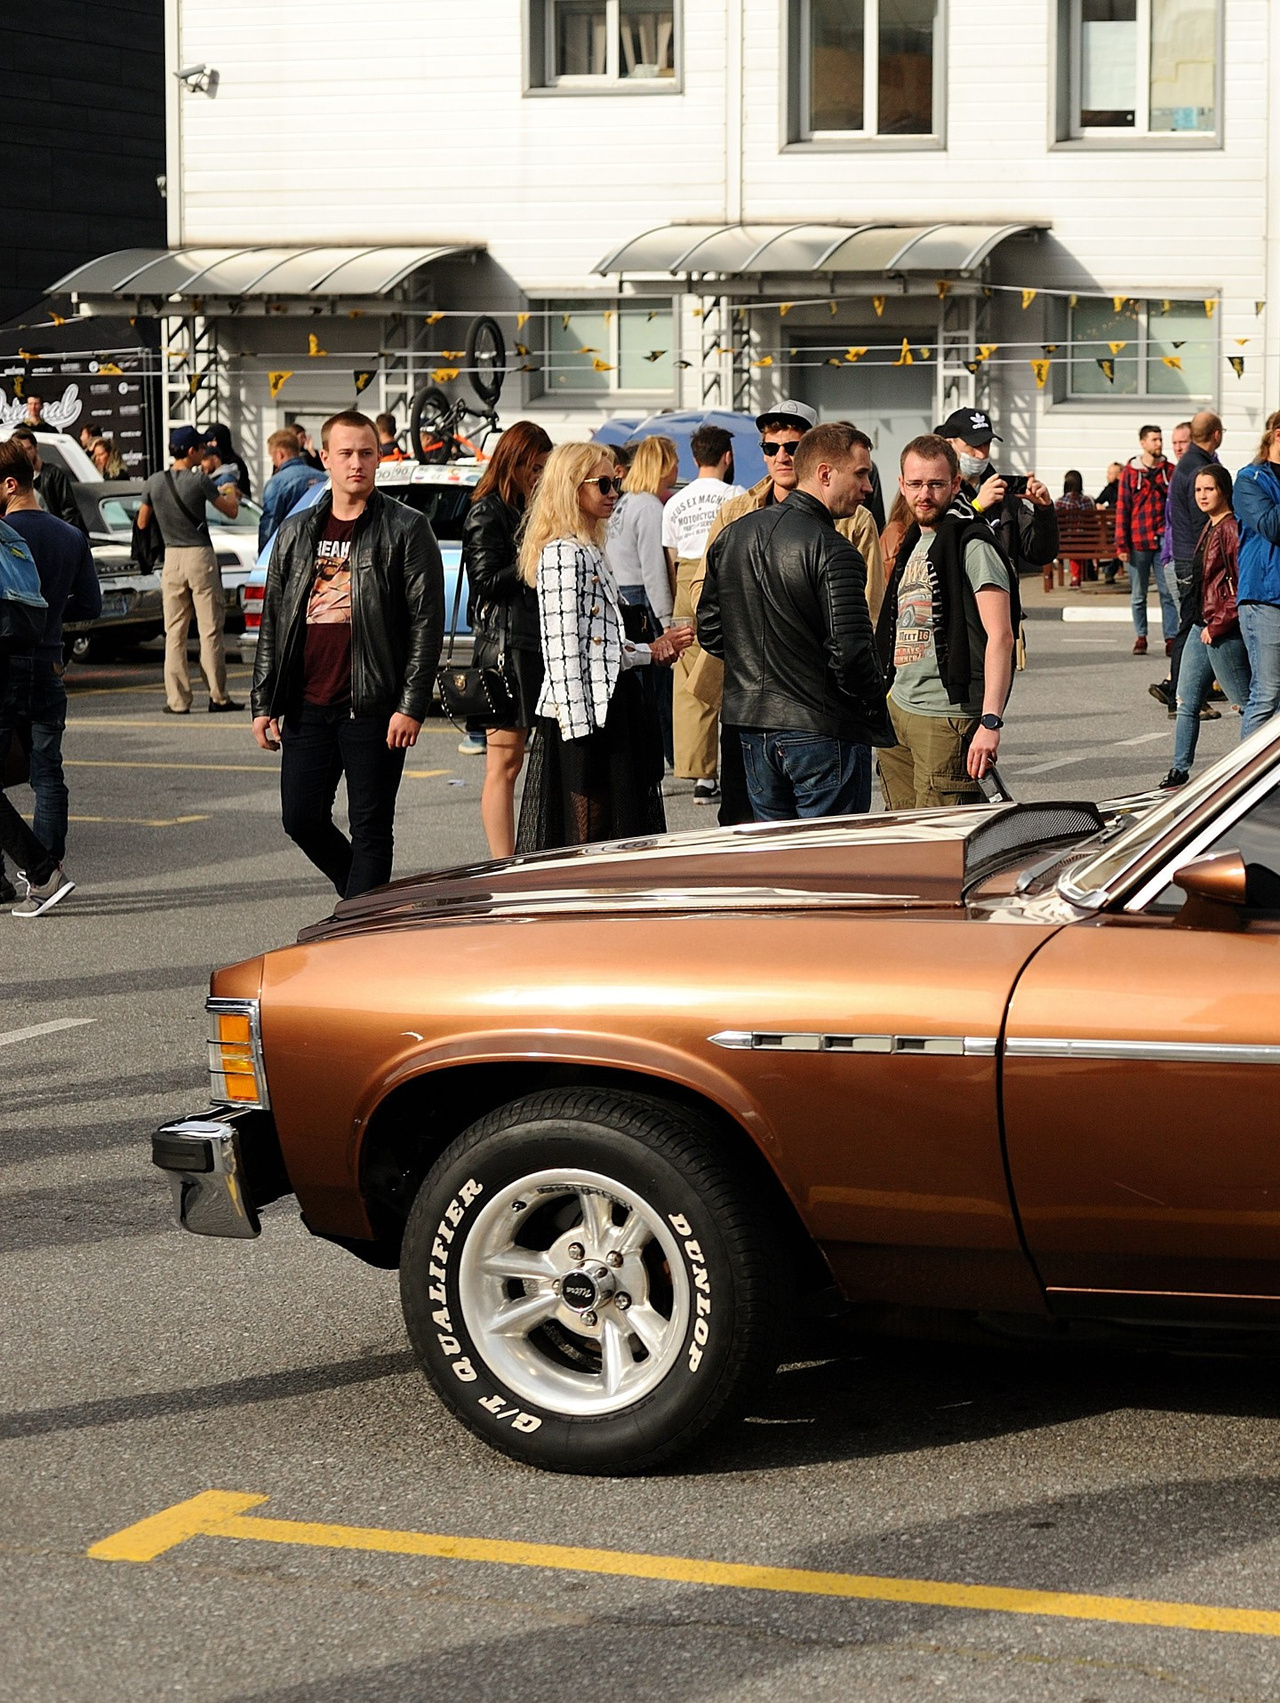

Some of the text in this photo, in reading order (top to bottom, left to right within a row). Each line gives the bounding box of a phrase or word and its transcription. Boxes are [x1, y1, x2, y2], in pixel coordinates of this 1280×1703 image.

[686, 496, 697, 508] EX
[918, 630, 930, 641] 16
[428, 1178, 543, 1433] G/T QUALIFIER
[667, 1212, 711, 1373] DUNLOP
